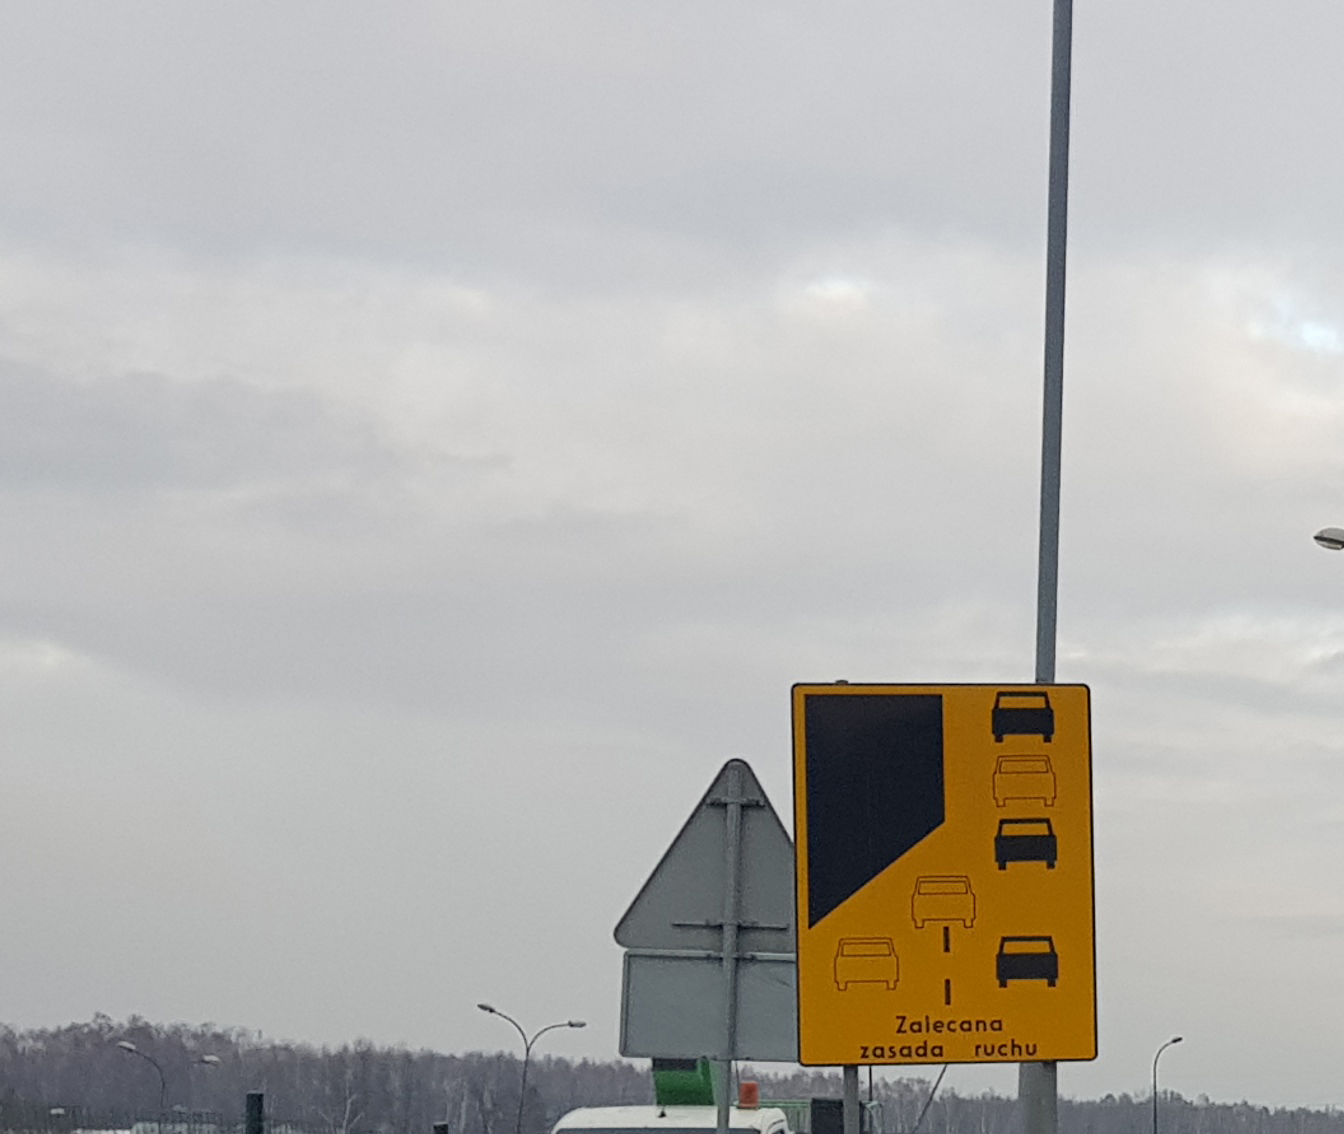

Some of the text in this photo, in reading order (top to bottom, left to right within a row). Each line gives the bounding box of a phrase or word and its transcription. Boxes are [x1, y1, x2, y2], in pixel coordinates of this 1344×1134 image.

[895, 1015, 1003, 1035] Zalecana
[860, 1038, 1038, 1059] zasada ruchu
